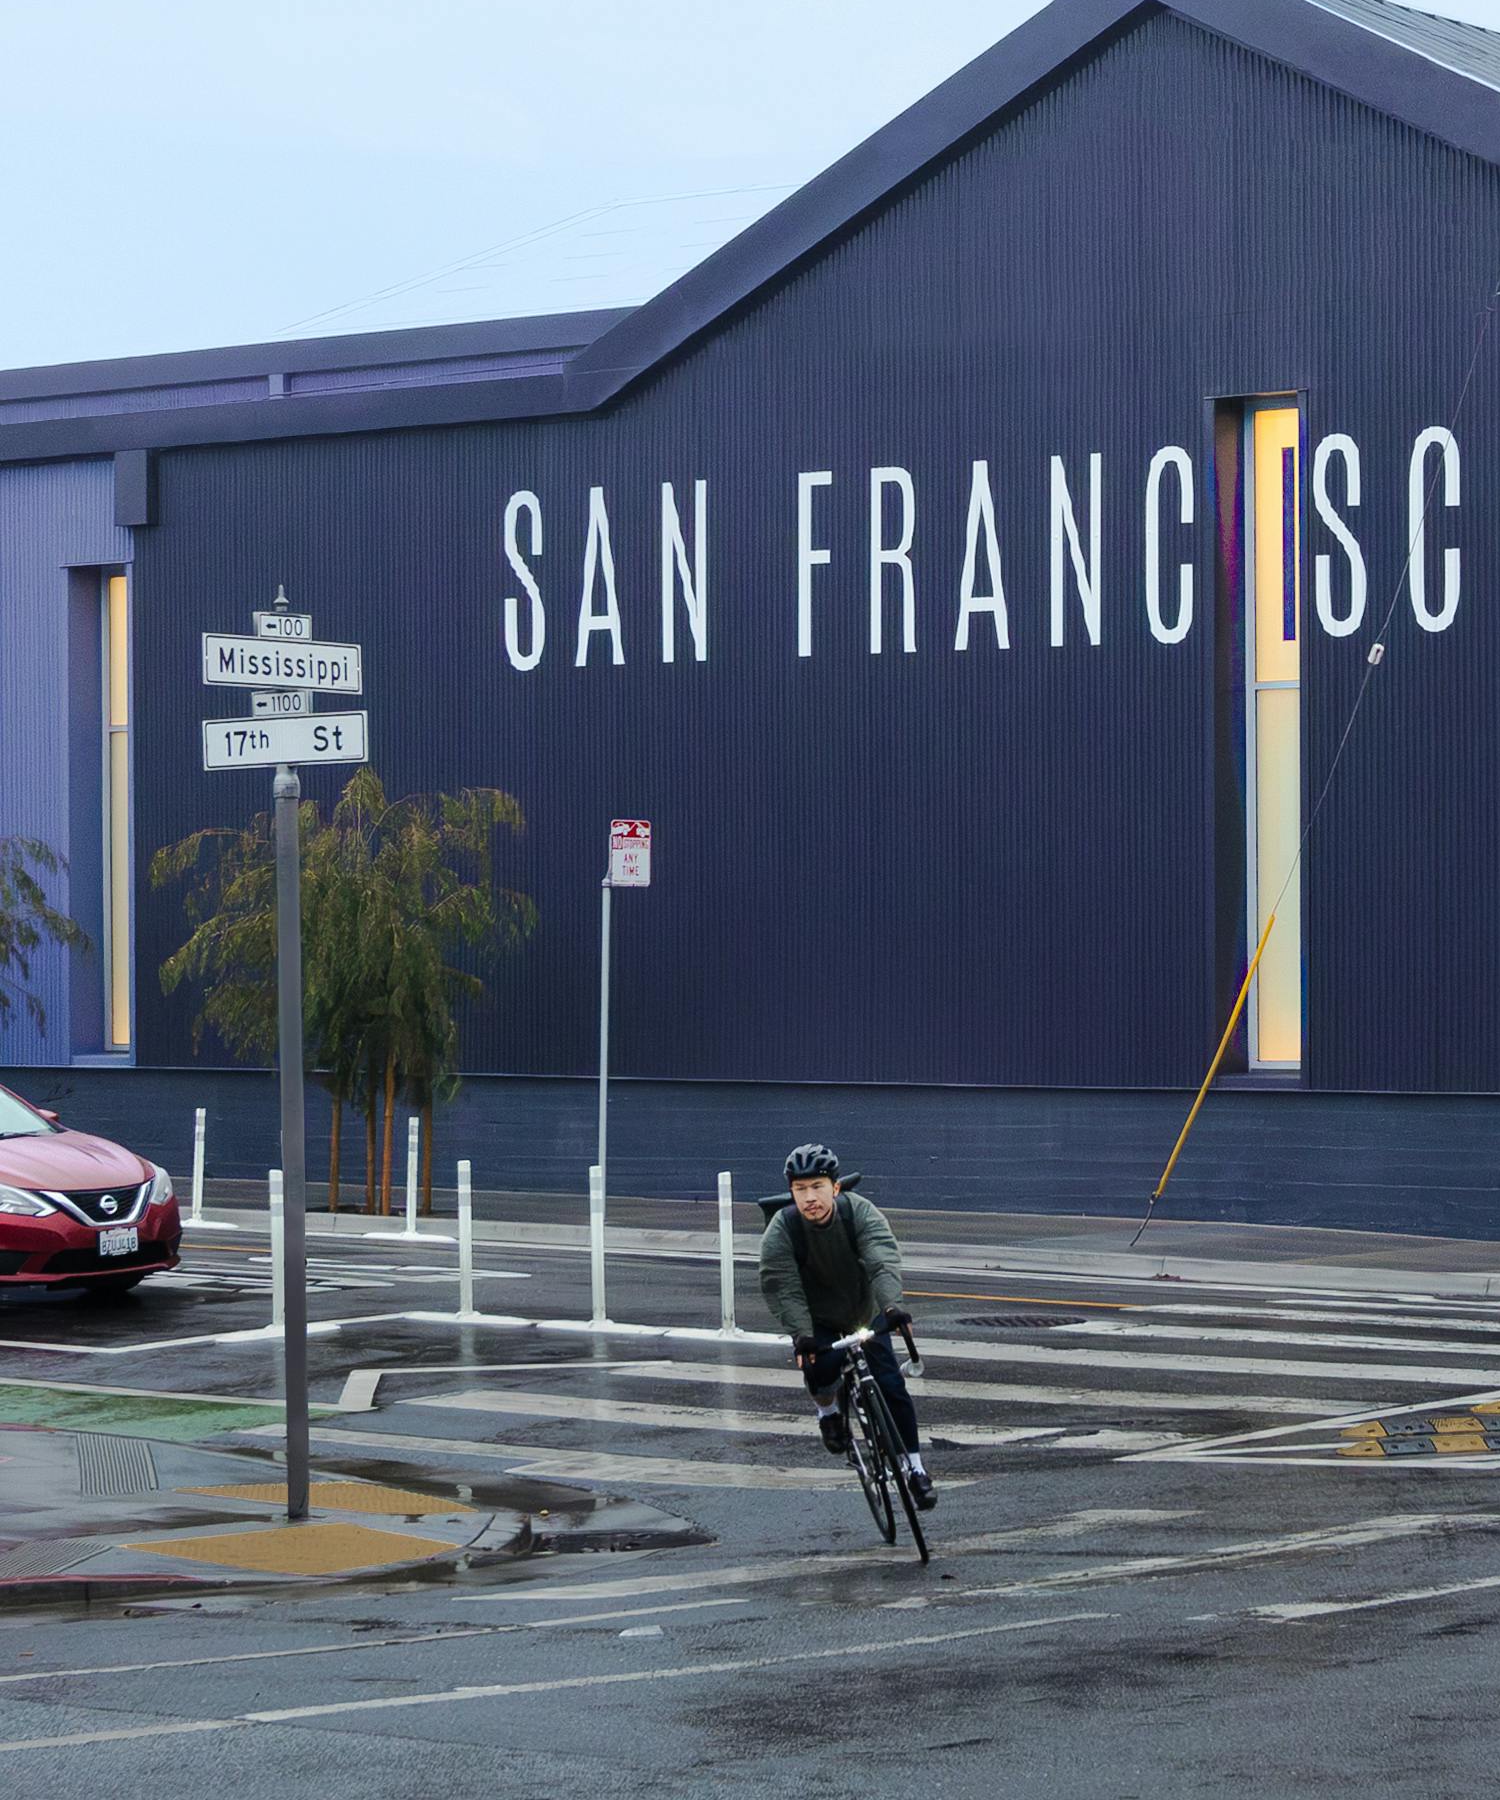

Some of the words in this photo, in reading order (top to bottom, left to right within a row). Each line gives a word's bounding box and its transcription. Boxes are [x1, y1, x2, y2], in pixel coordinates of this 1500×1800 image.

[504, 480, 707, 670] SAN
[277, 618, 303, 636] 100
[218, 646, 349, 686] Mississippi
[271, 694, 302, 712] 1100
[224, 729, 270, 757] 17th
[313, 724, 343, 752] St
[612, 836, 623, 849] NO
[624, 853, 639, 864] ANY
[622, 865, 640, 876] TIME
